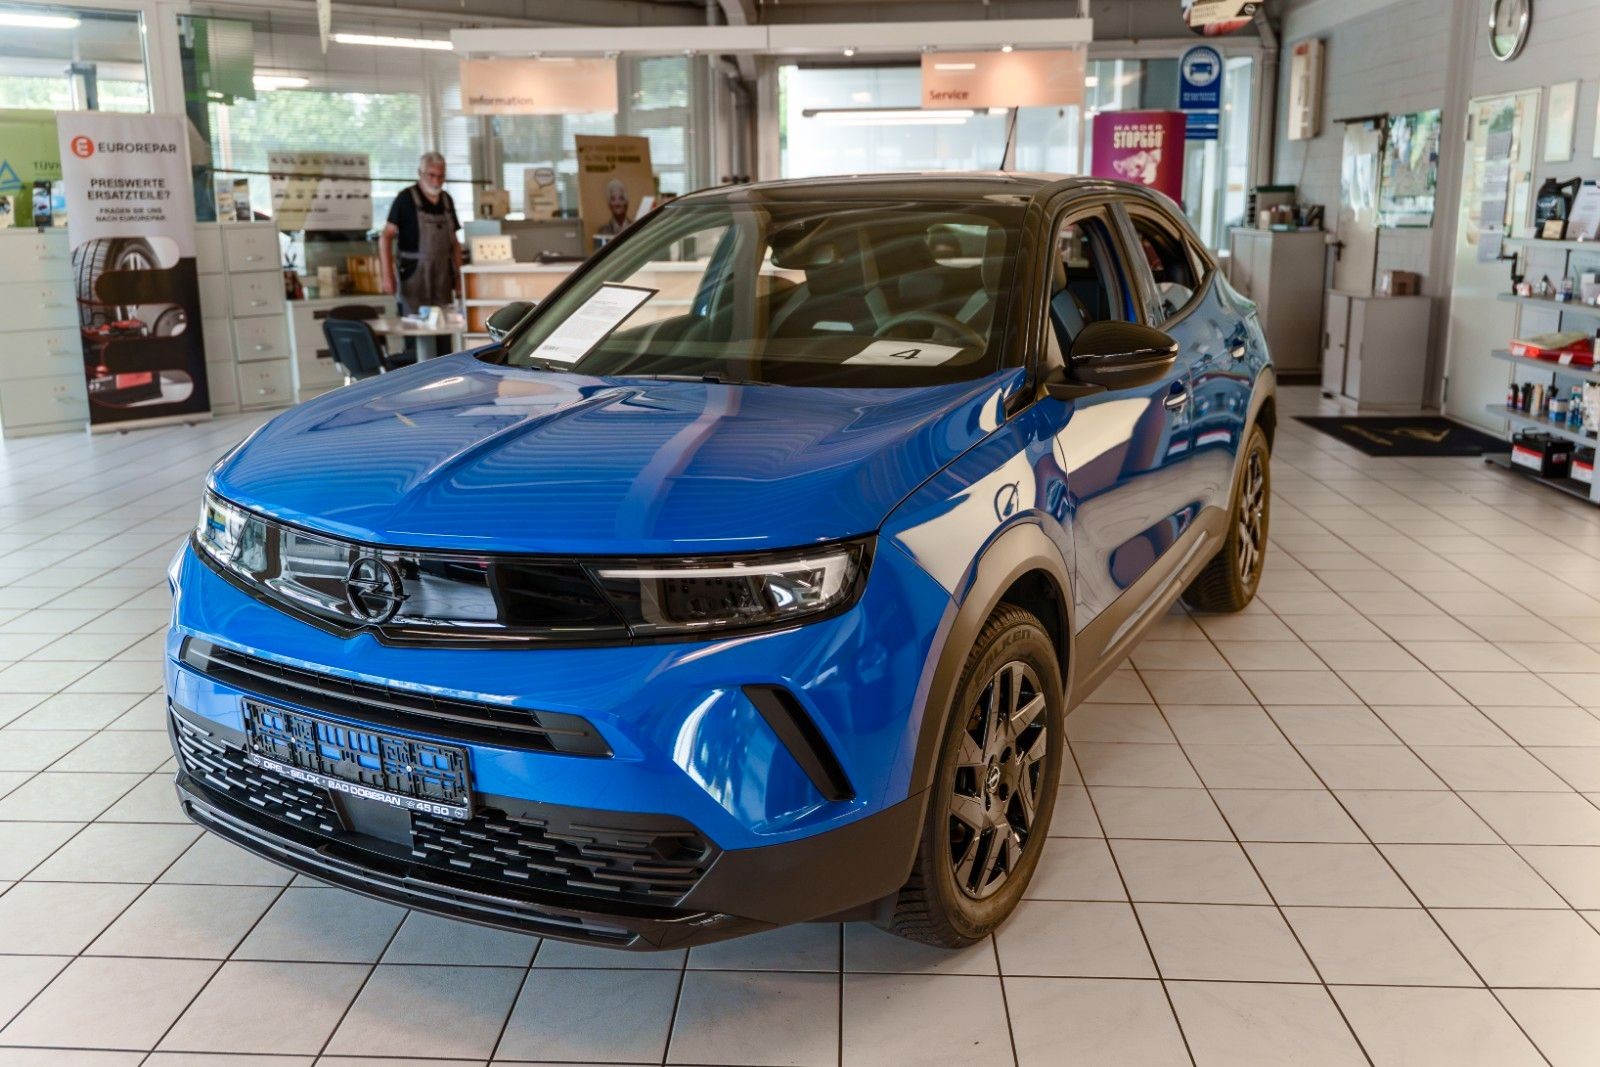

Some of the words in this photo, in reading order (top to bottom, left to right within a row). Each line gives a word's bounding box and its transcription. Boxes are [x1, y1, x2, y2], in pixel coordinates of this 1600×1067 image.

[468, 94, 534, 106] Information
[929, 90, 969, 100] Service
[98, 142, 177, 154] EUROREPAR
[90, 178, 166, 189] PREISWERTE
[87, 190, 171, 201] ERSATZTEILE?
[889, 348, 922, 360] 4
[328, 780, 349, 793] BAD
[350, 786, 401, 806] DOBERAN
